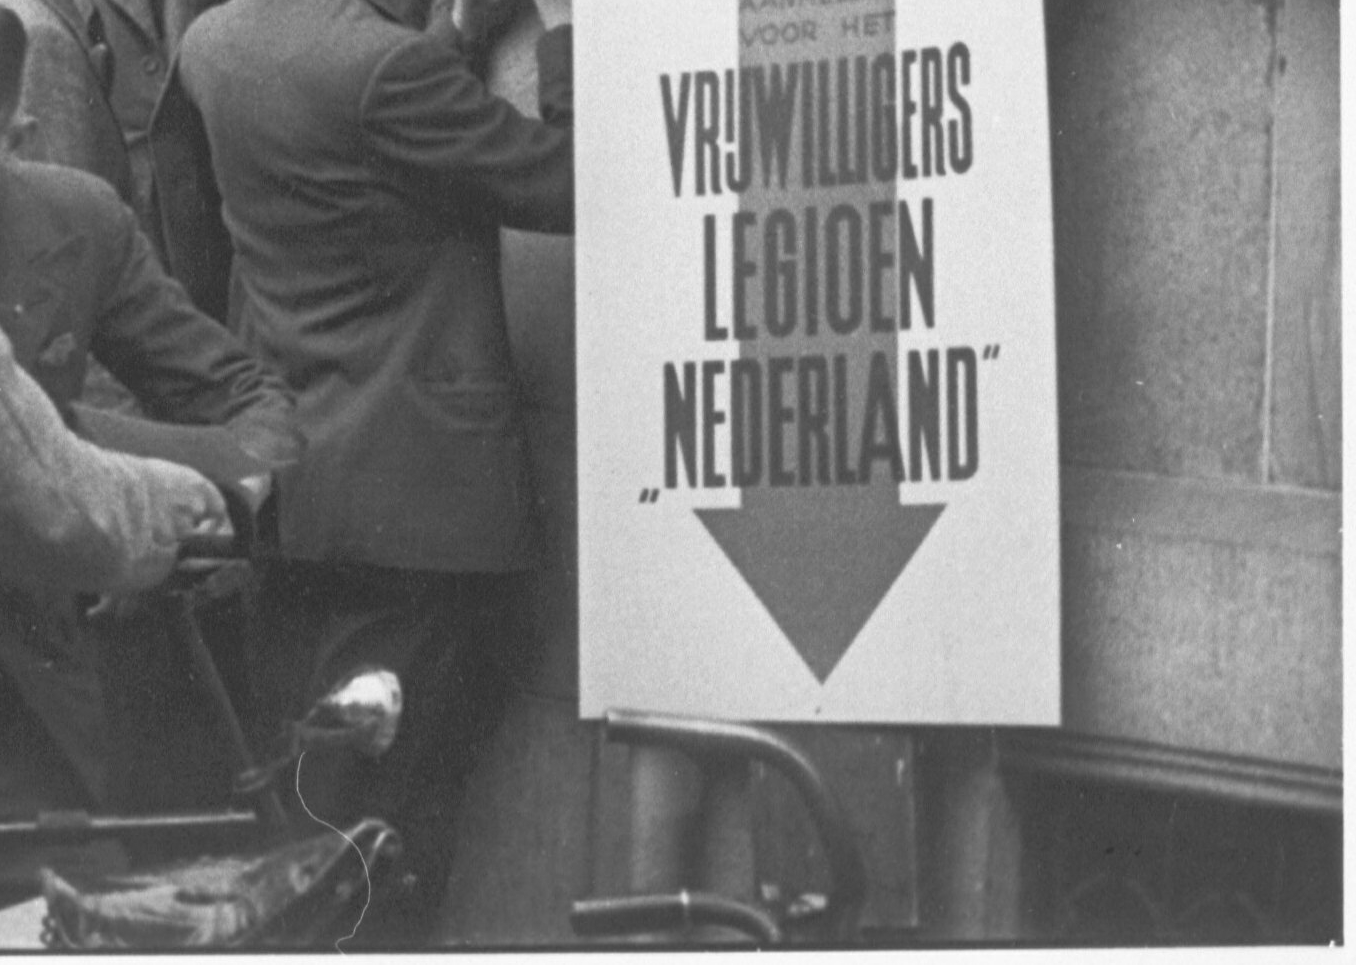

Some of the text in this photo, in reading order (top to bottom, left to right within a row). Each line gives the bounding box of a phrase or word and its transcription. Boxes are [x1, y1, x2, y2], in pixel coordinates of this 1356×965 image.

[738, 10, 896, 48] VOOR HET
[658, 40, 974, 198] VRIJWILLIGERS
[703, 197, 936, 342] LEGIOEN
